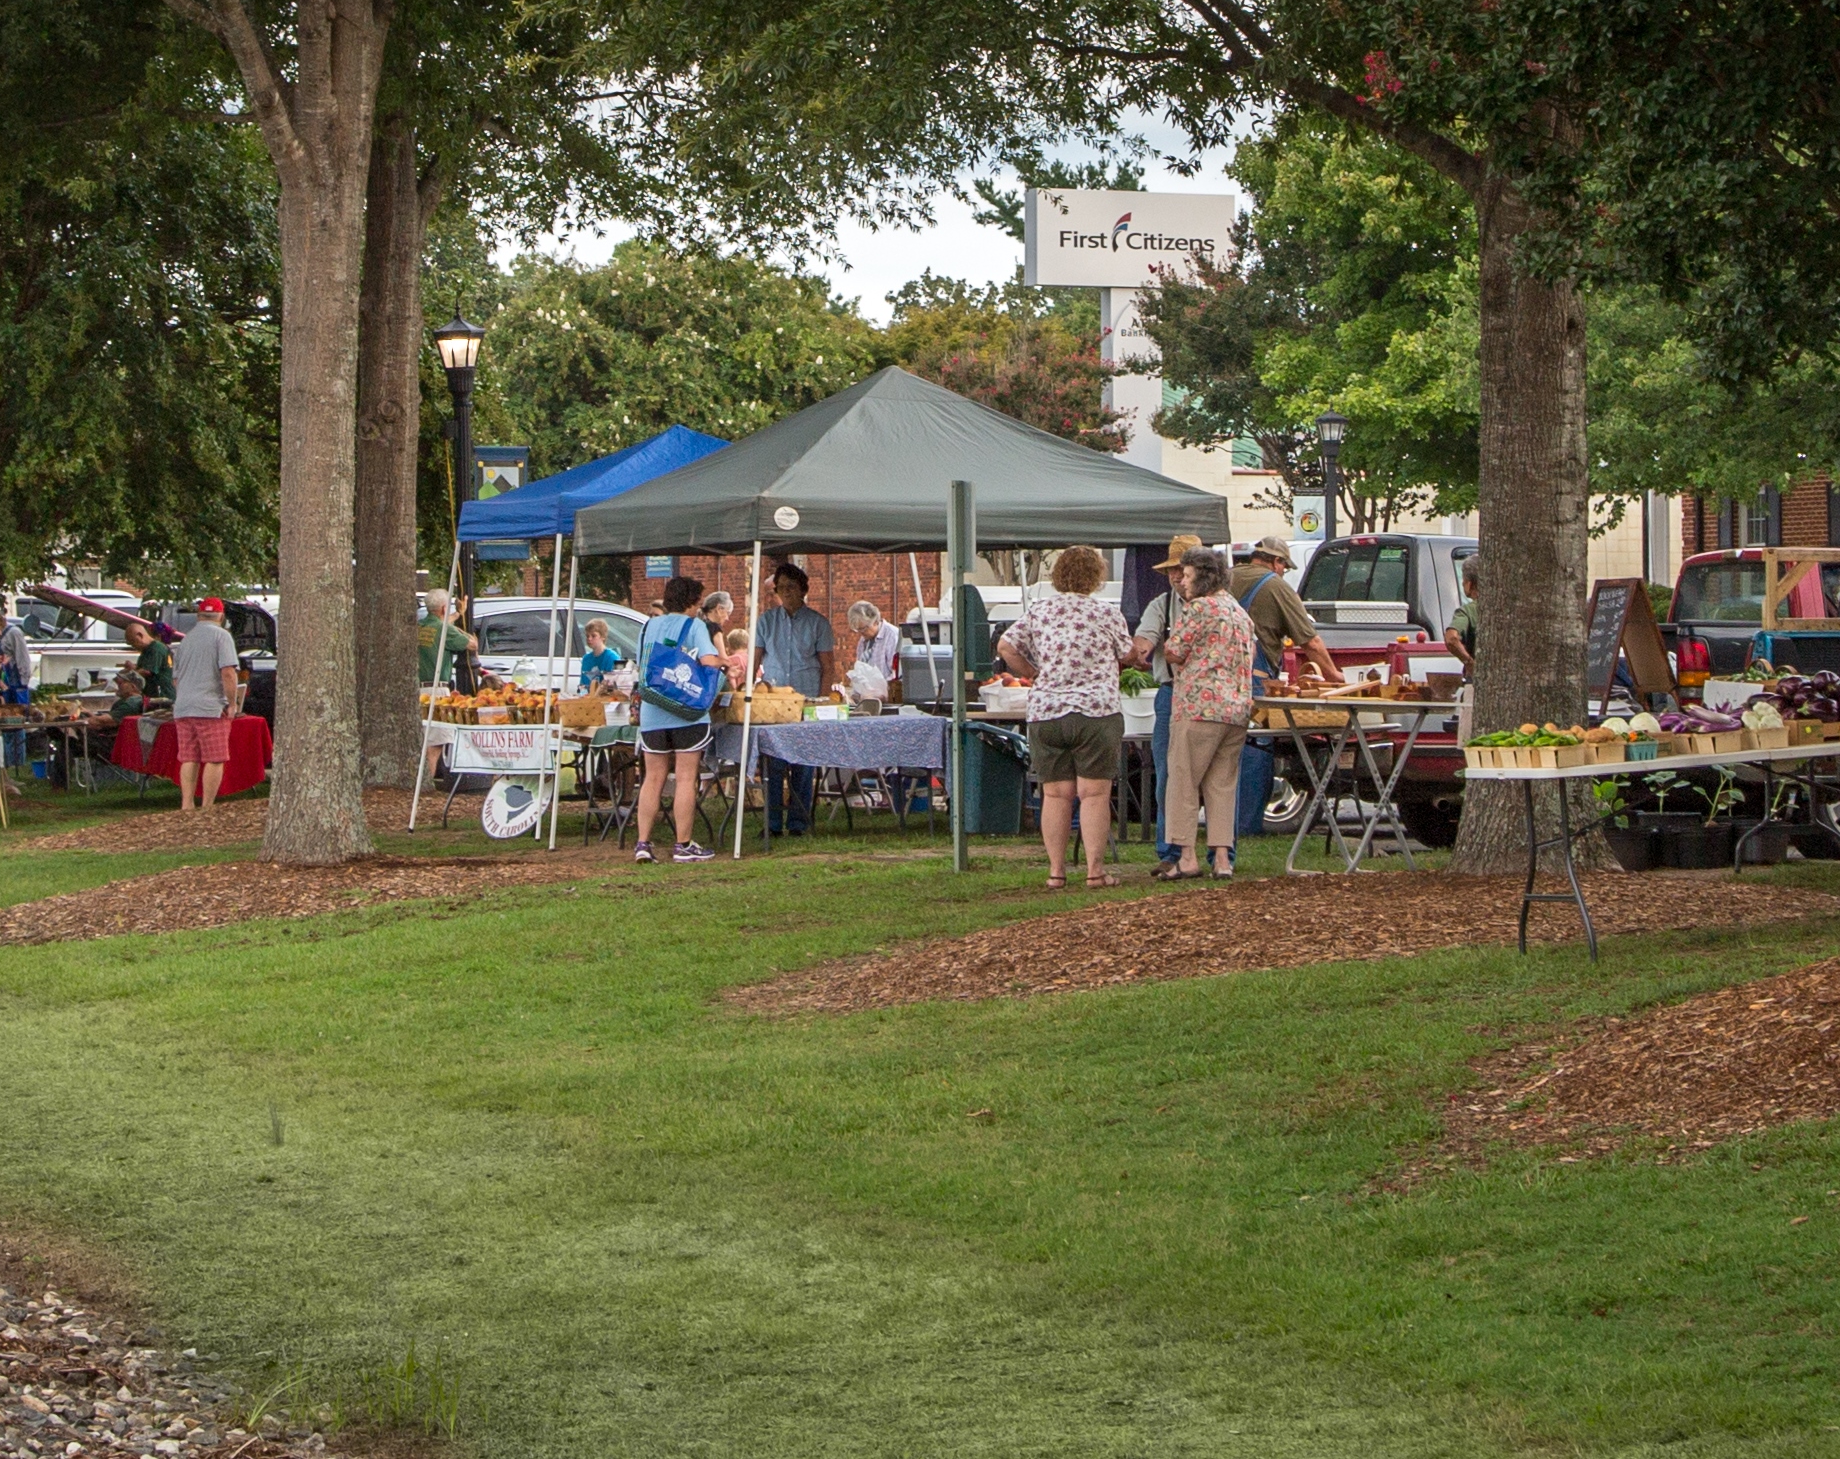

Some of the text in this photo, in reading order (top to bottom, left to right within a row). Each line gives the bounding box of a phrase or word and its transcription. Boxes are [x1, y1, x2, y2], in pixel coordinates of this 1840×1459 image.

[1060, 230, 1215, 252] First Citizens
[471, 731, 534, 748] ROLLINS FARM
[484, 798, 500, 835] SOUTH
